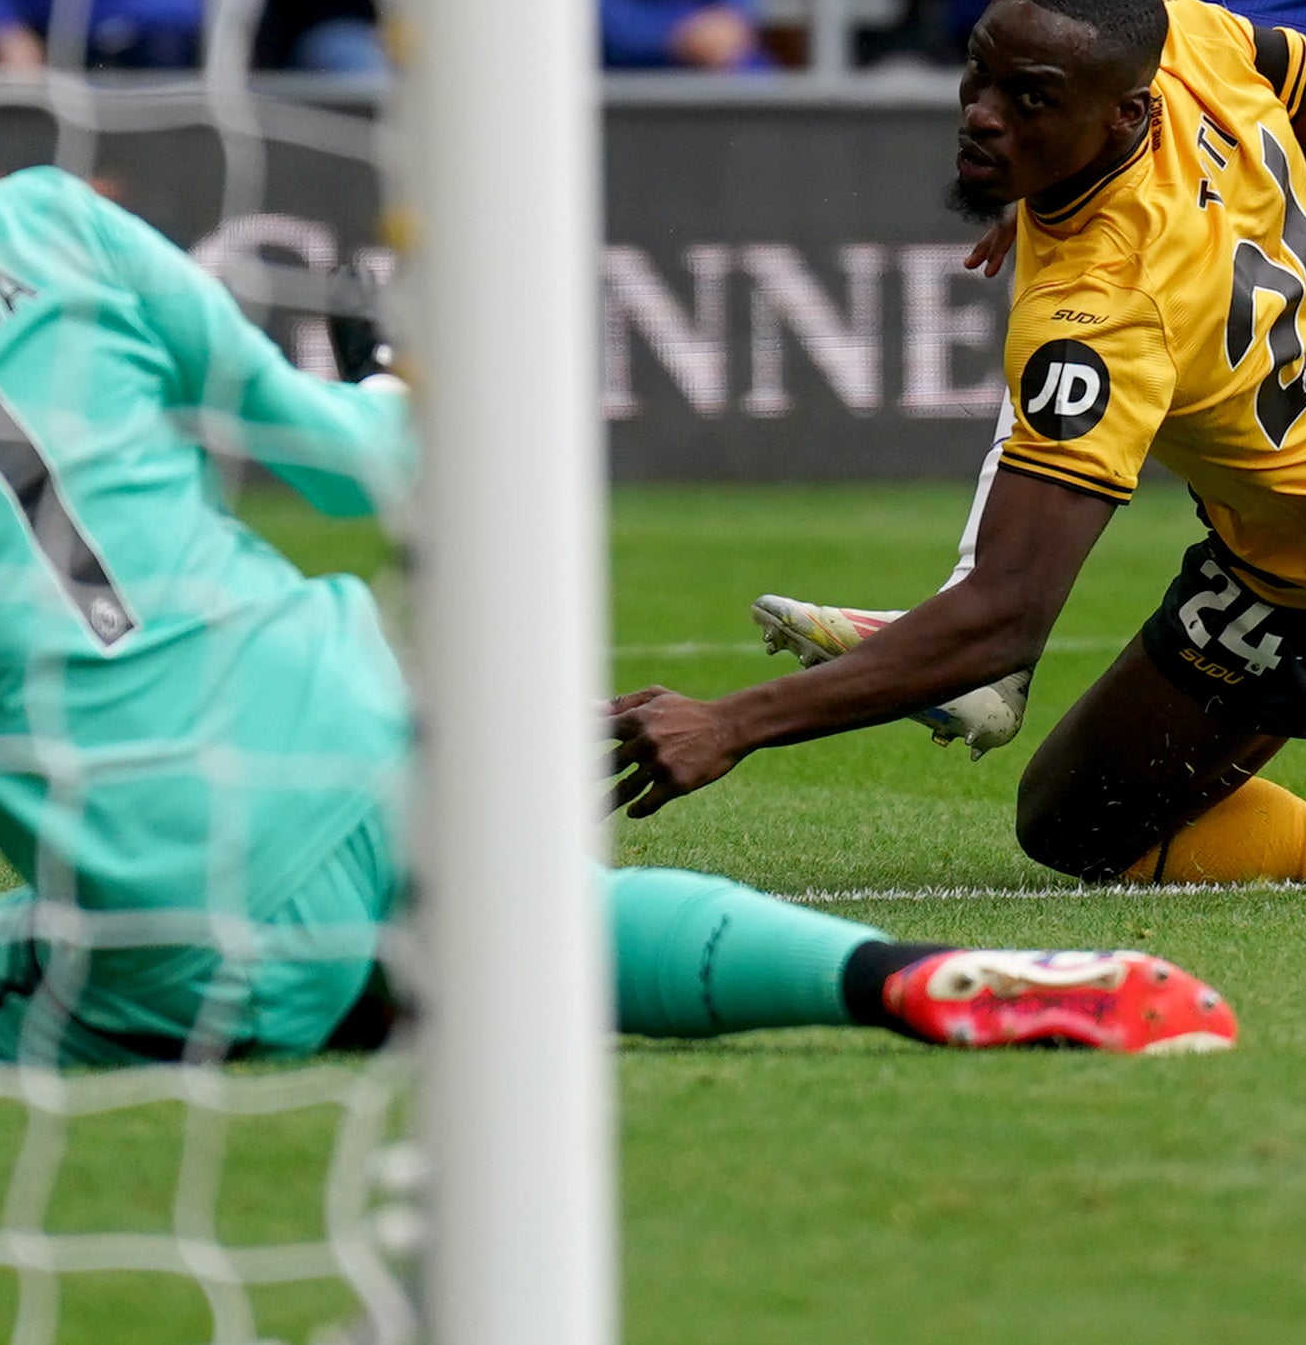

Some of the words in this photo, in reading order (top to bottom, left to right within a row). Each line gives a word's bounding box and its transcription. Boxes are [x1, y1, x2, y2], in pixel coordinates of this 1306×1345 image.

[1196, 111, 1239, 211] TTI
[1027, 361, 1102, 417] JD
[1178, 559, 1284, 677] 24
[1178, 648, 1245, 685] SUDU
